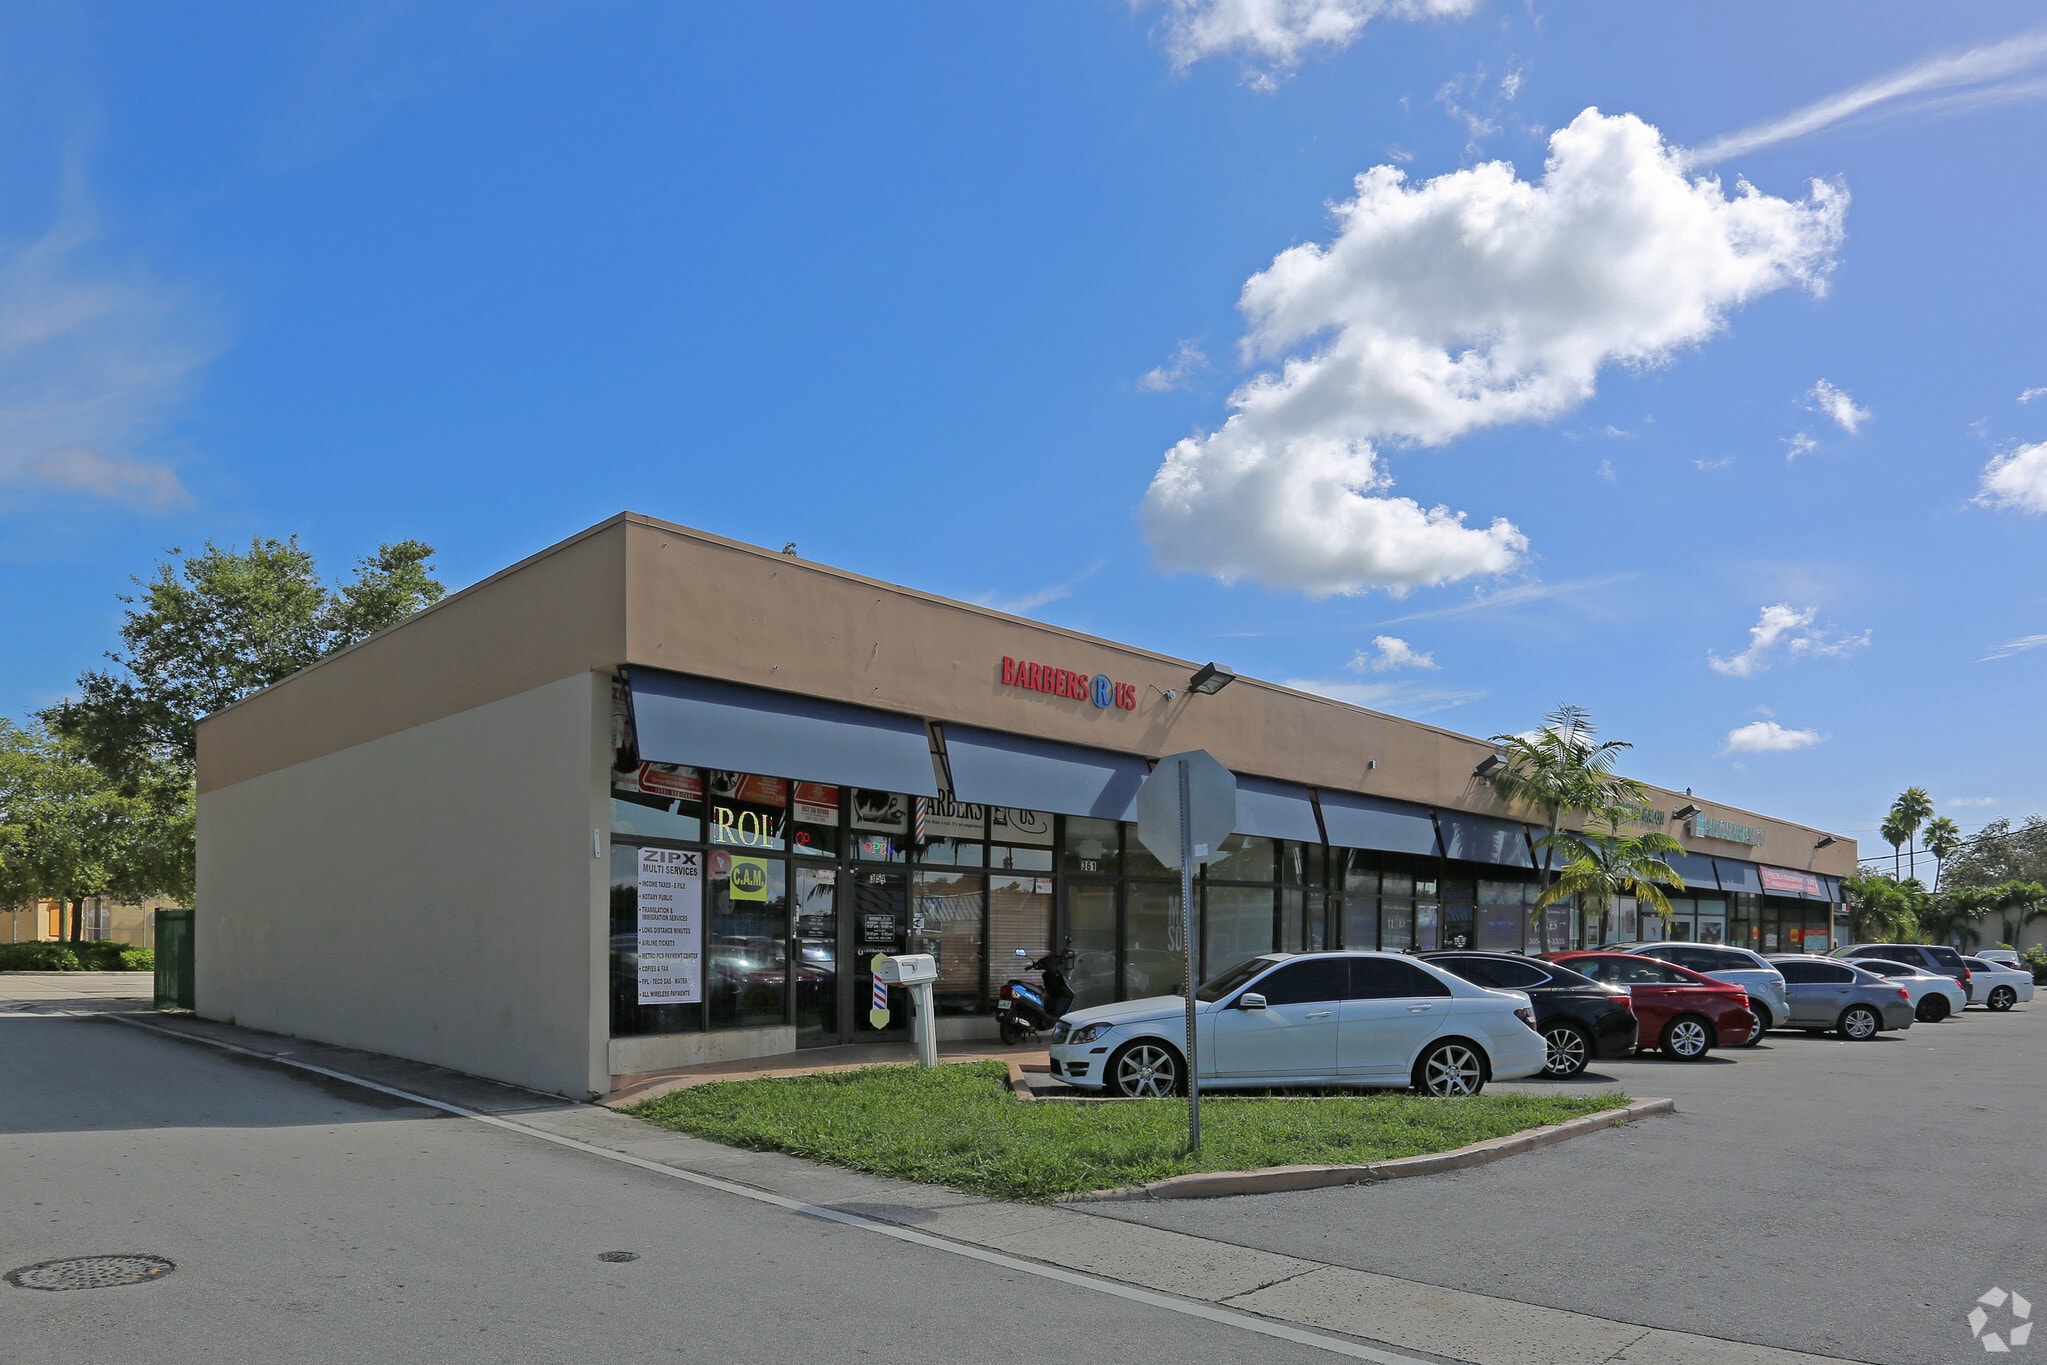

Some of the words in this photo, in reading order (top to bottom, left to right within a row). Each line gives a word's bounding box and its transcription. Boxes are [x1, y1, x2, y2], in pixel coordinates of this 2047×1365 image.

[1002, 656, 1090, 702] BARBERS
[1094, 675, 1111, 707] R
[1115, 681, 1137, 711] US
[643, 850, 697, 865] ZIPX
[643, 863, 664, 874] MULTI
[665, 865, 698, 877] SERVICES
[1081, 861, 1097, 872] 361
[733, 867, 765, 887] C.A.M.
[642, 906, 670, 914] TRANSLATION
[670, 914, 688, 922] SERVICES
